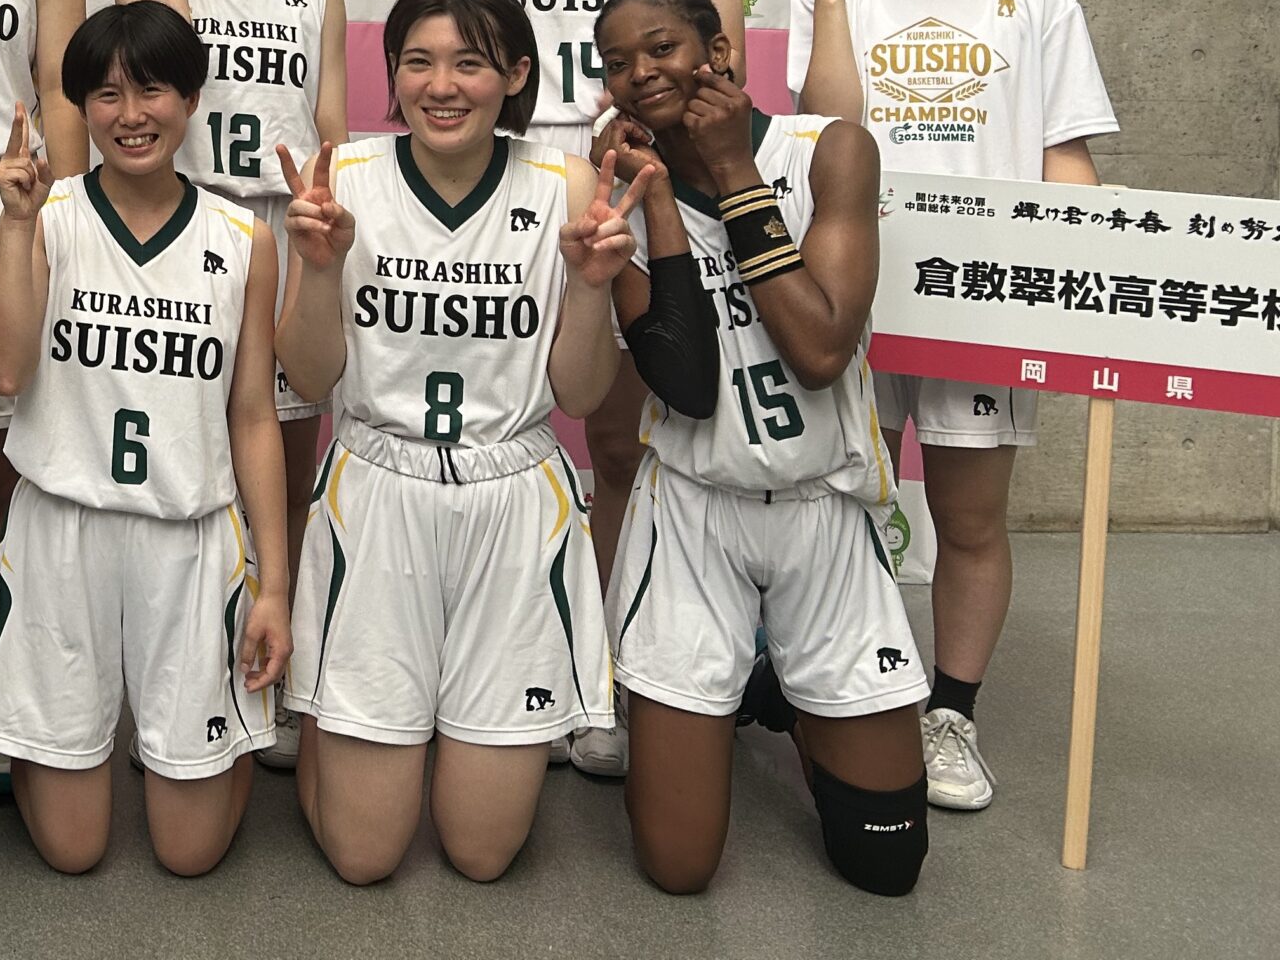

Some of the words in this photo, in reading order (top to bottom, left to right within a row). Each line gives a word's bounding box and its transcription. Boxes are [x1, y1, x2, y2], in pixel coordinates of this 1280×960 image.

[192, 17, 298, 44] URASHIKI
[906, 31, 955, 41] KURASHIKI
[201, 43, 308, 89] ISHO
[870, 43, 992, 78] SUISHO
[907, 76, 955, 86] BASKETBALL
[869, 106, 988, 126] CHAMPION
[917, 123, 975, 133] OKAYAMA
[206, 111, 261, 178] 12
[898, 133, 924, 142] 2025
[928, 133, 975, 143] SUMMER
[904, 201, 951, 215] 中国総体
[956, 206, 996, 218] 2025
[915, 192, 986, 207] 開け未来の扉
[1011, 200, 1172, 235] 輝け君の青春
[375, 254, 523, 285] KURASHIKI
[70, 288, 212, 326] KURASHIKI
[354, 284, 540, 340] SUISHO
[51, 318, 224, 381] SUISHO
[1020, 358, 1195, 401] 岡山県
[423, 370, 465, 444] 8
[732, 359, 806, 445] 15
[111, 407, 150, 486] 6
